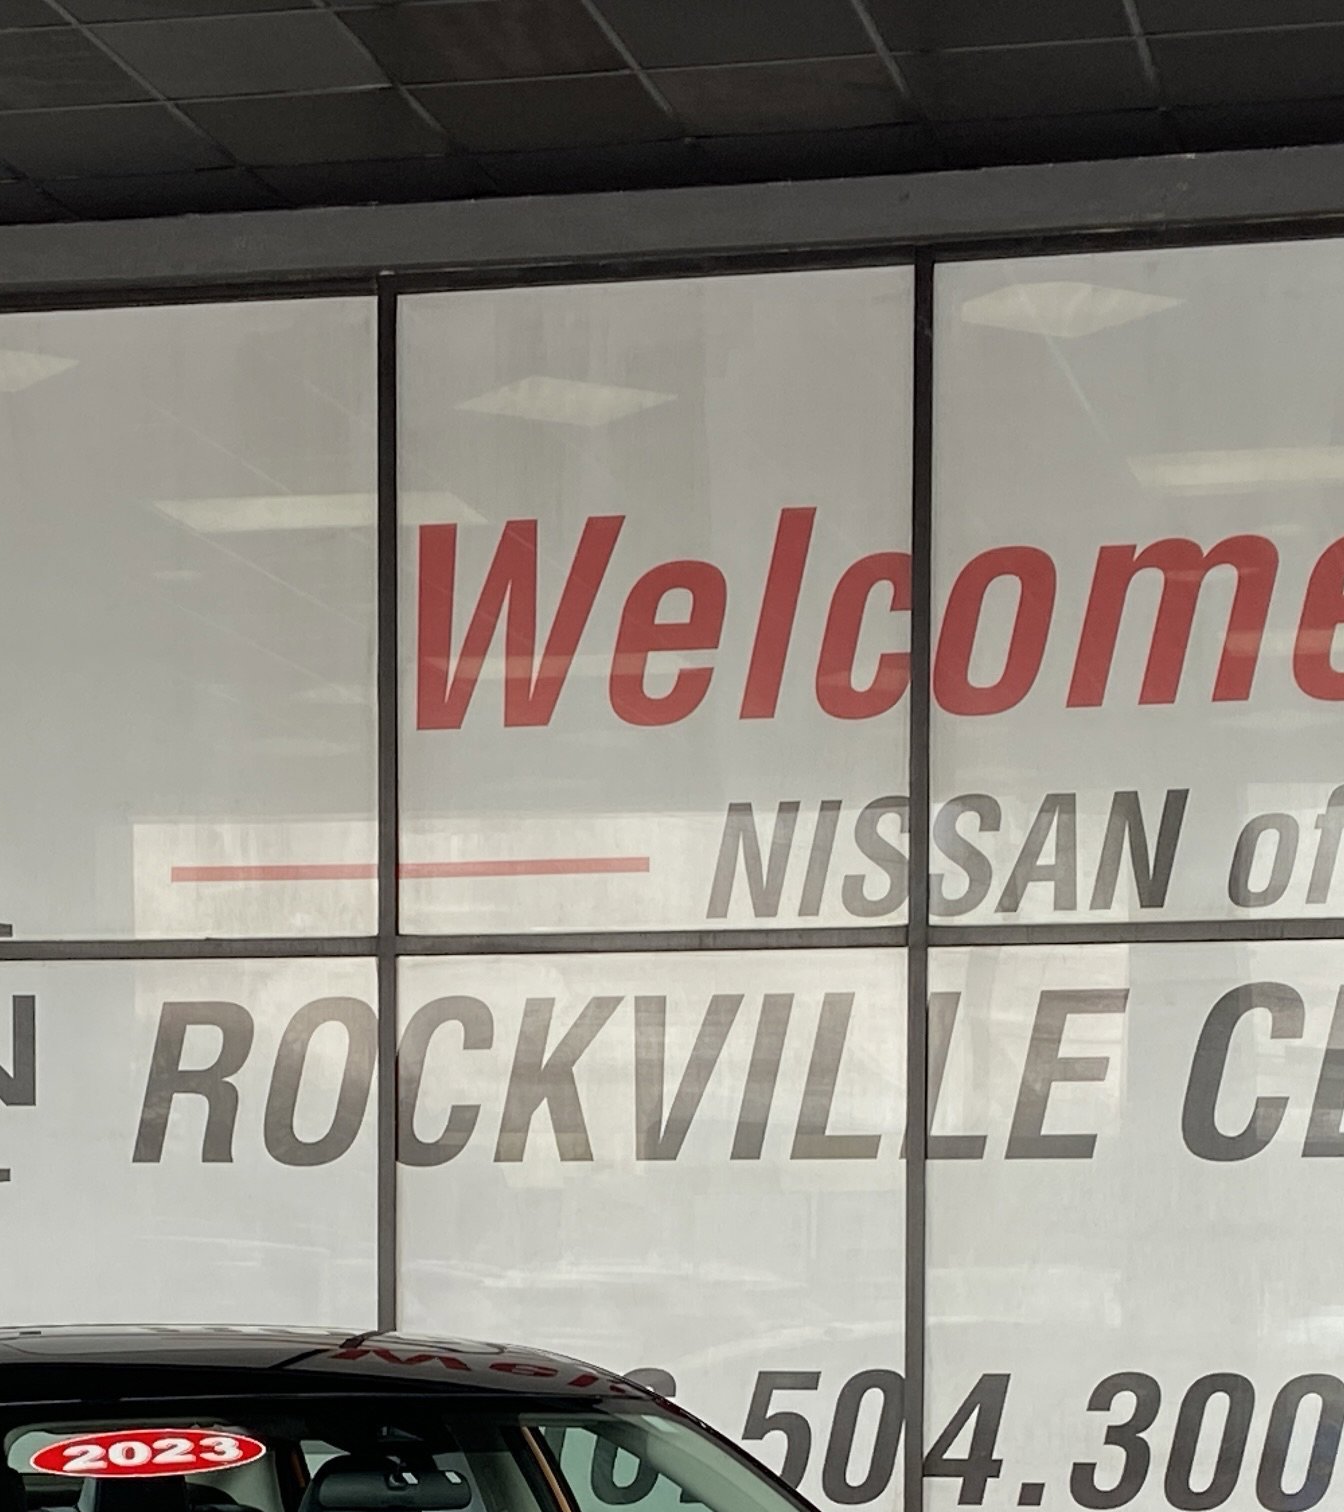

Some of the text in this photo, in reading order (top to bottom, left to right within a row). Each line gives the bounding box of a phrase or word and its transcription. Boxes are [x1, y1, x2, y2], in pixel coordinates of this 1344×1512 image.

[706, 787, 1190, 920] NISSAN
[132, 987, 1130, 1168] ROCKVILLE
[62, 1437, 244, 1472] 2023
